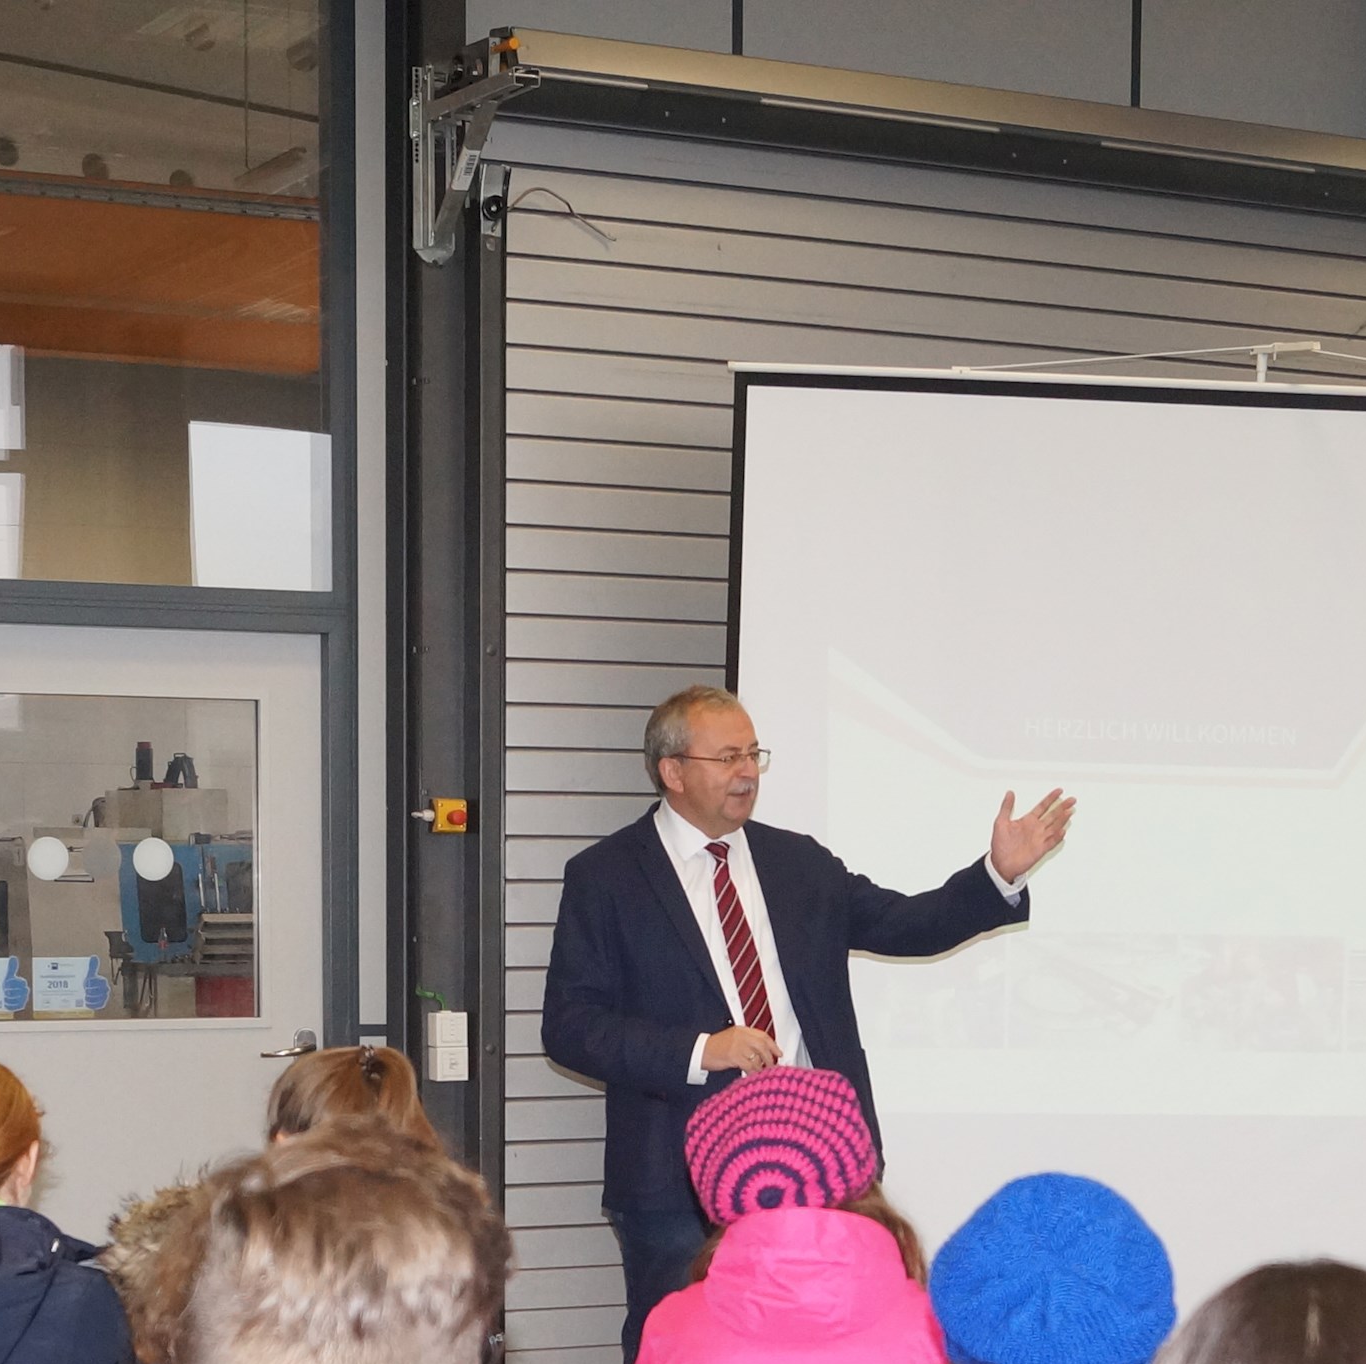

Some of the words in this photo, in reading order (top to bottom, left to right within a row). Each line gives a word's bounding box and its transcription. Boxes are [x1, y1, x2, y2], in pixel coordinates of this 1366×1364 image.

[1025, 718, 1137, 743] HERZLICH
[1145, 722, 1297, 746] WILLKOMMEN
[47, 980, 69, 989] 2018
